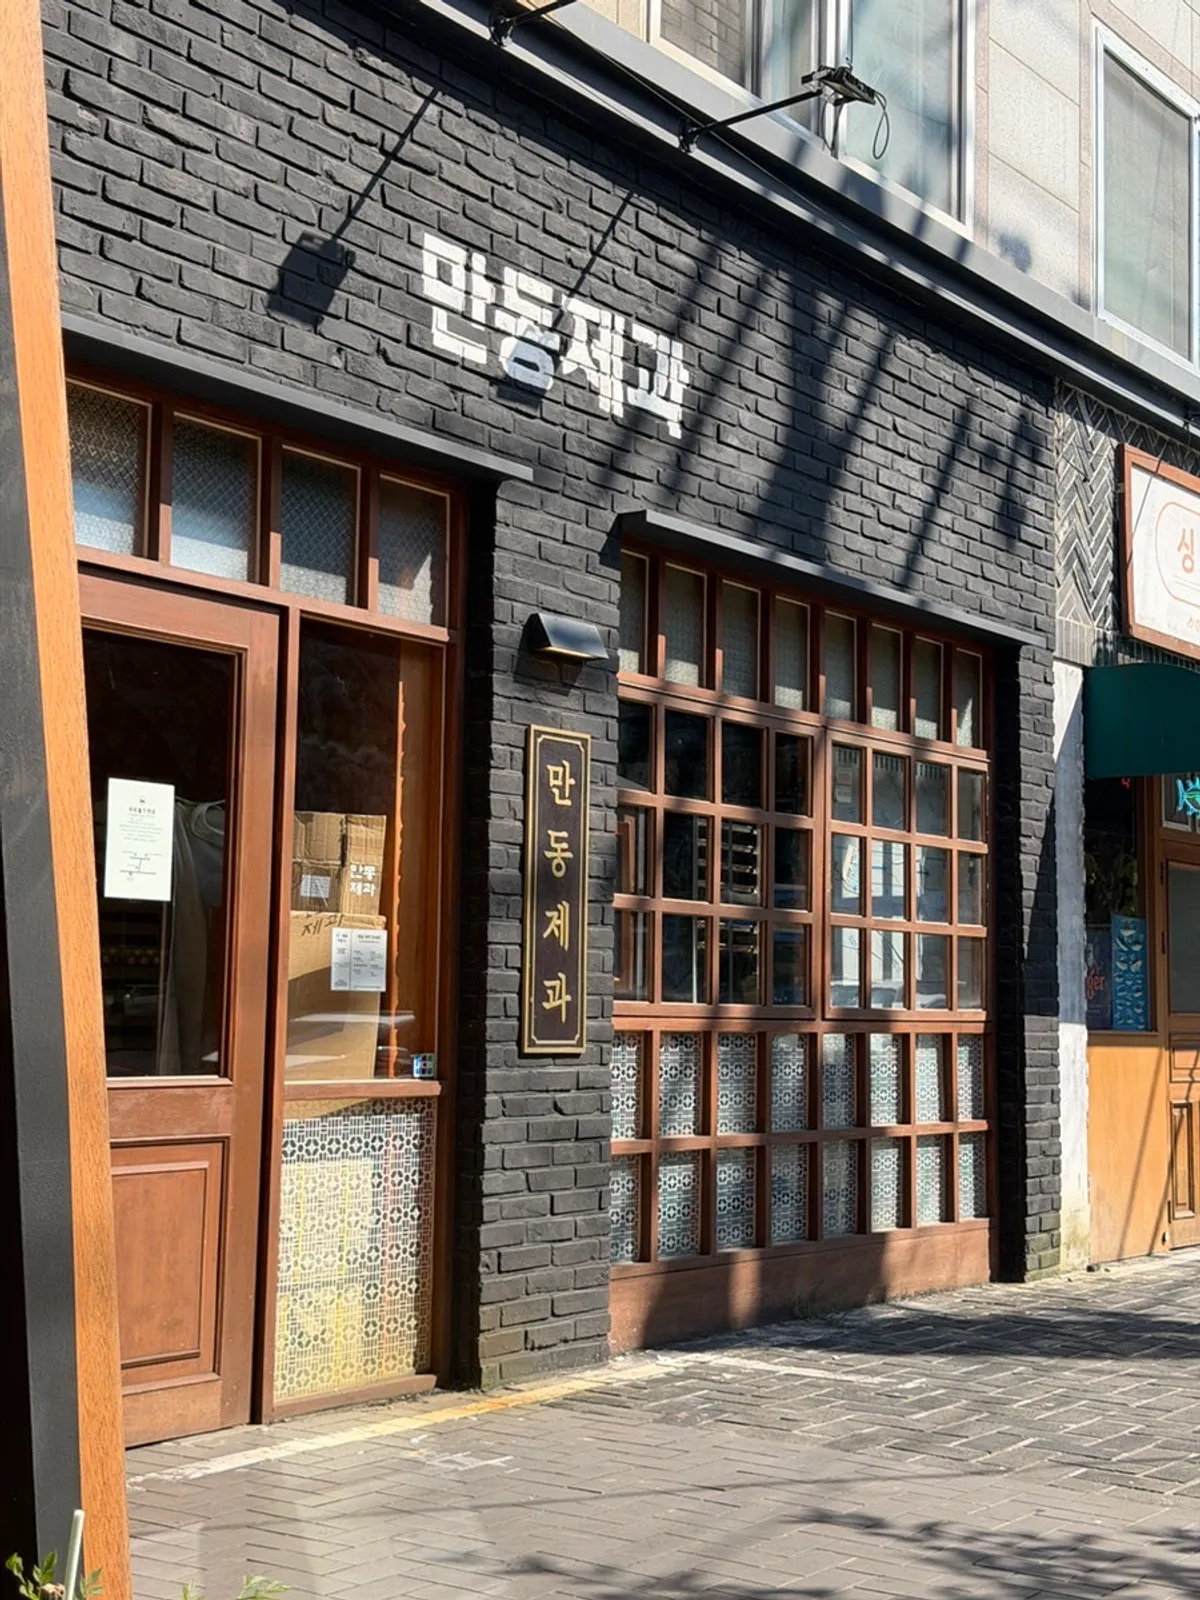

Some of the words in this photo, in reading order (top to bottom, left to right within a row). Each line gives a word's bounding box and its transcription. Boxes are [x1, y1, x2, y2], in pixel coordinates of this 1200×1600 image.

[422, 232, 690, 439] 만동제과
[350, 864, 376, 880] 만동
[350, 882, 376, 896] 제과
[542, 760, 576, 1023] 만동제과
